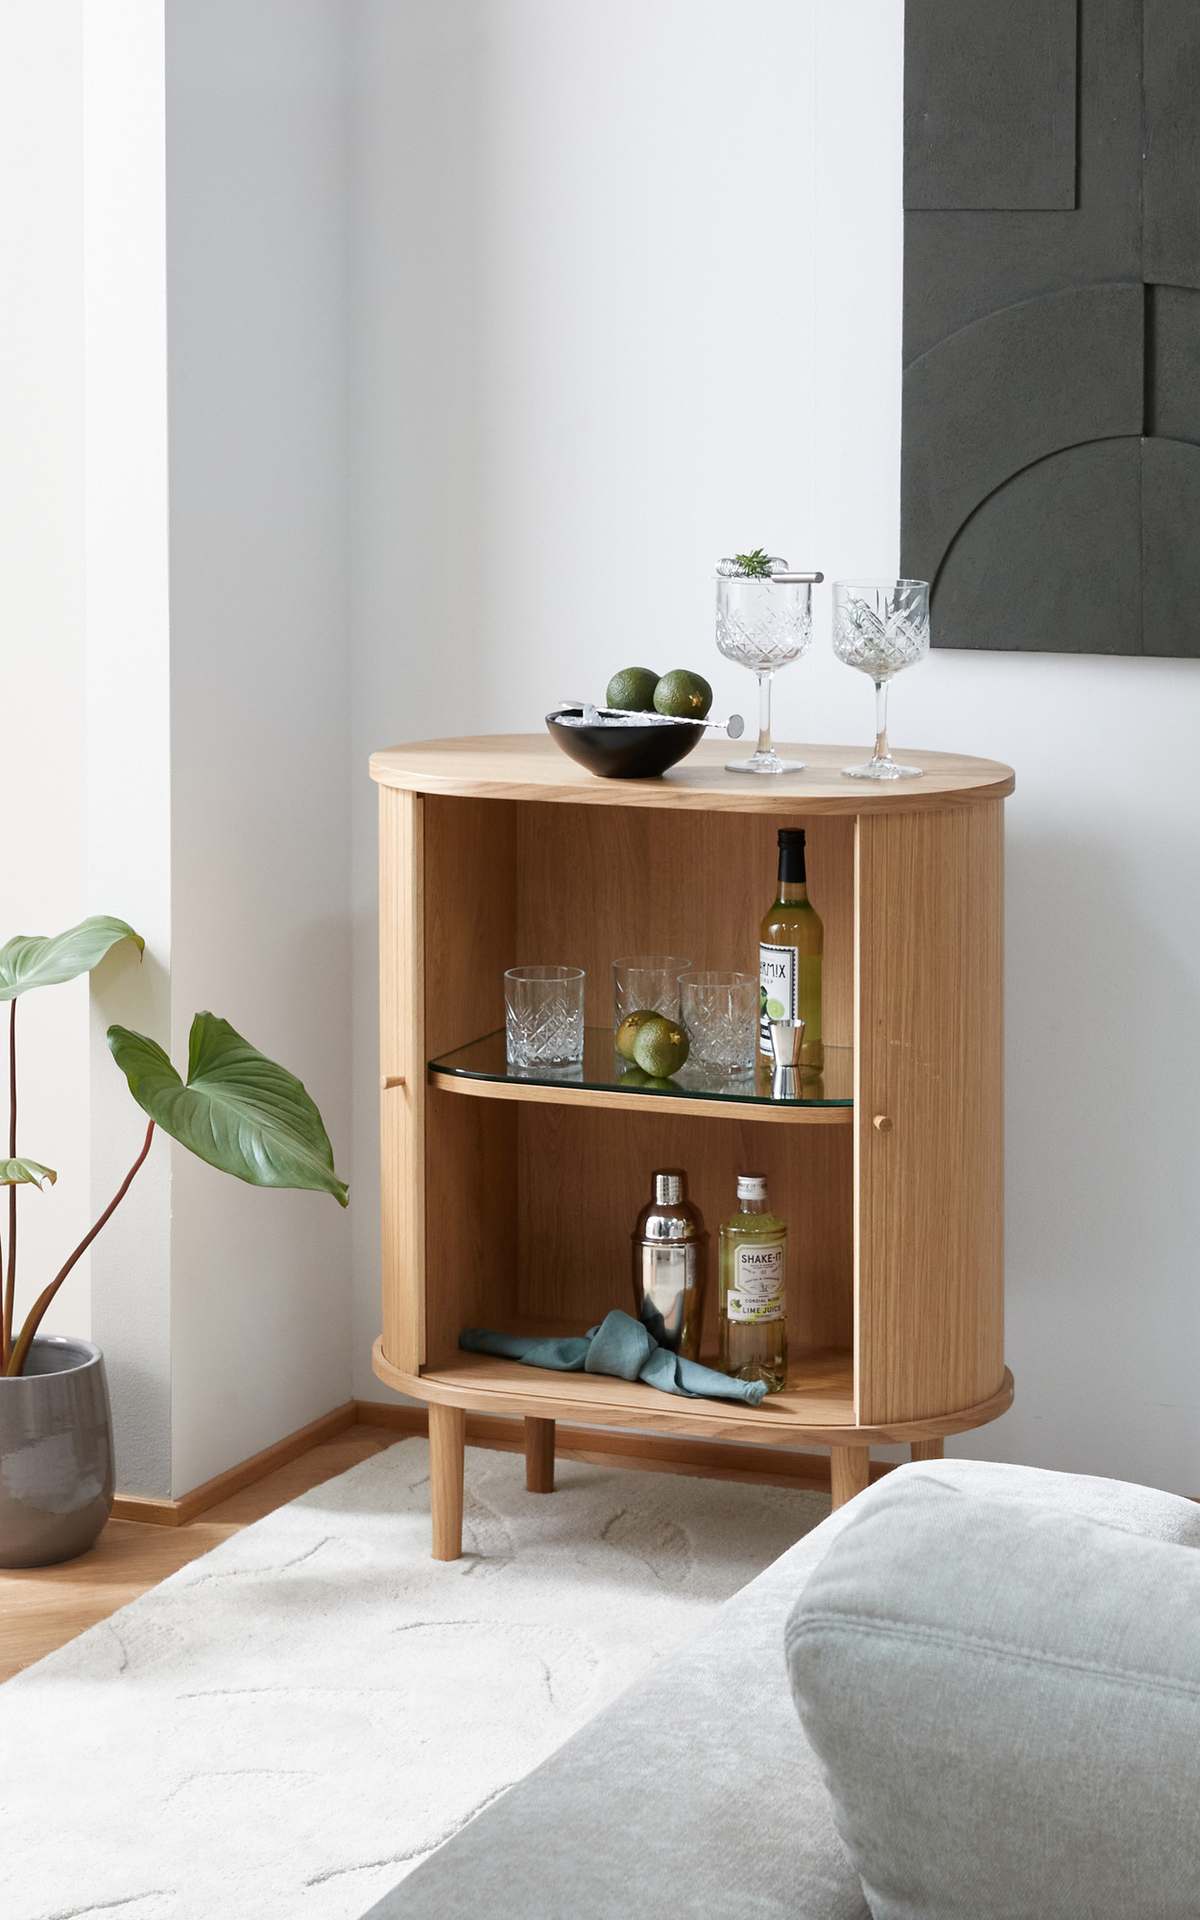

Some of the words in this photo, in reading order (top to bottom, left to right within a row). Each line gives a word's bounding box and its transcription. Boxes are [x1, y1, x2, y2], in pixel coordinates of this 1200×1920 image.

[741, 1252, 782, 1264] SHAKE-IT
[742, 1306, 761, 1314] LIME
[763, 1304, 781, 1314] JUICE
